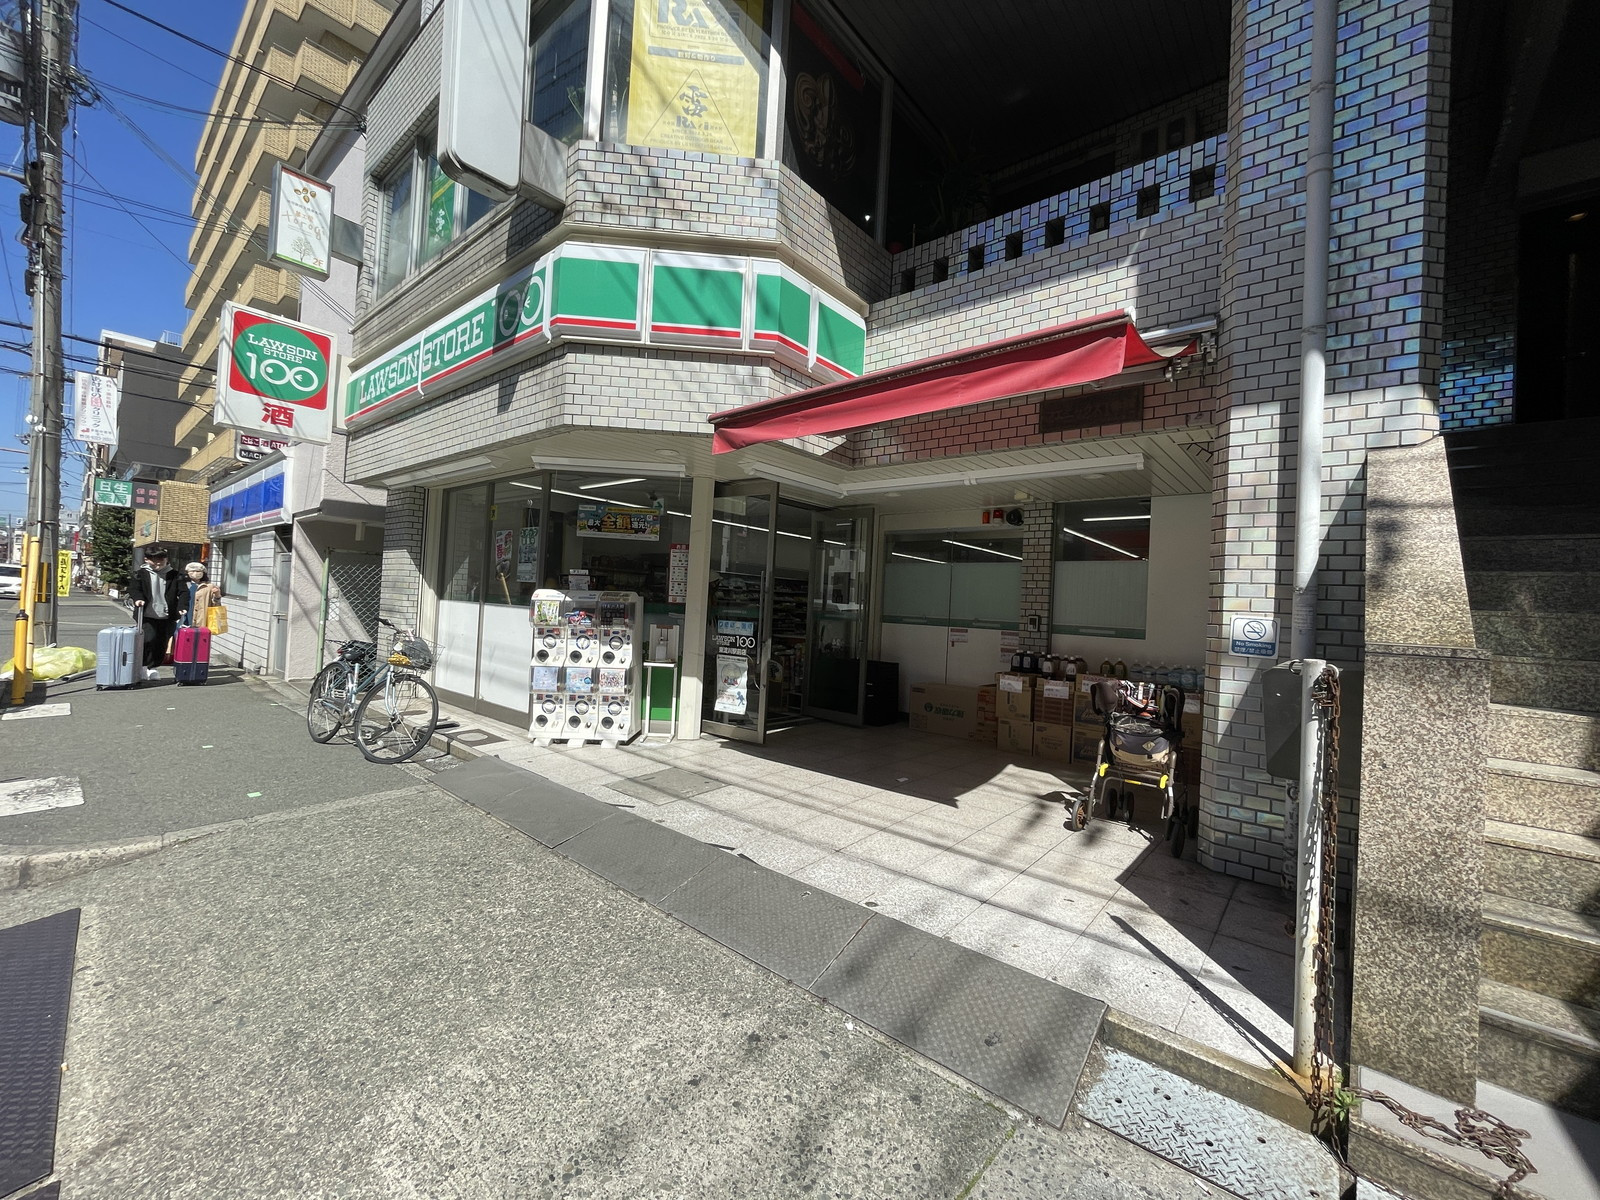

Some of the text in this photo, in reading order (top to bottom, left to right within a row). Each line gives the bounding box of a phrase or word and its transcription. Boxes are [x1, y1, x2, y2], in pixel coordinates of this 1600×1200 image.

[248, 333, 318, 361] LAWSON
[263, 347, 303, 364] STORE
[359, 346, 420, 404] LAWSON
[421, 312, 485, 373] STORE
[246, 352, 318, 391] 100
[262, 402, 294, 428] 酒
[242, 436, 259, 446] たばこ
[101, 481, 128, 494] 日生
[98, 492, 127, 505] 薬局
[601, 513, 631, 529] 全額
[736, 635, 755, 648] 100
